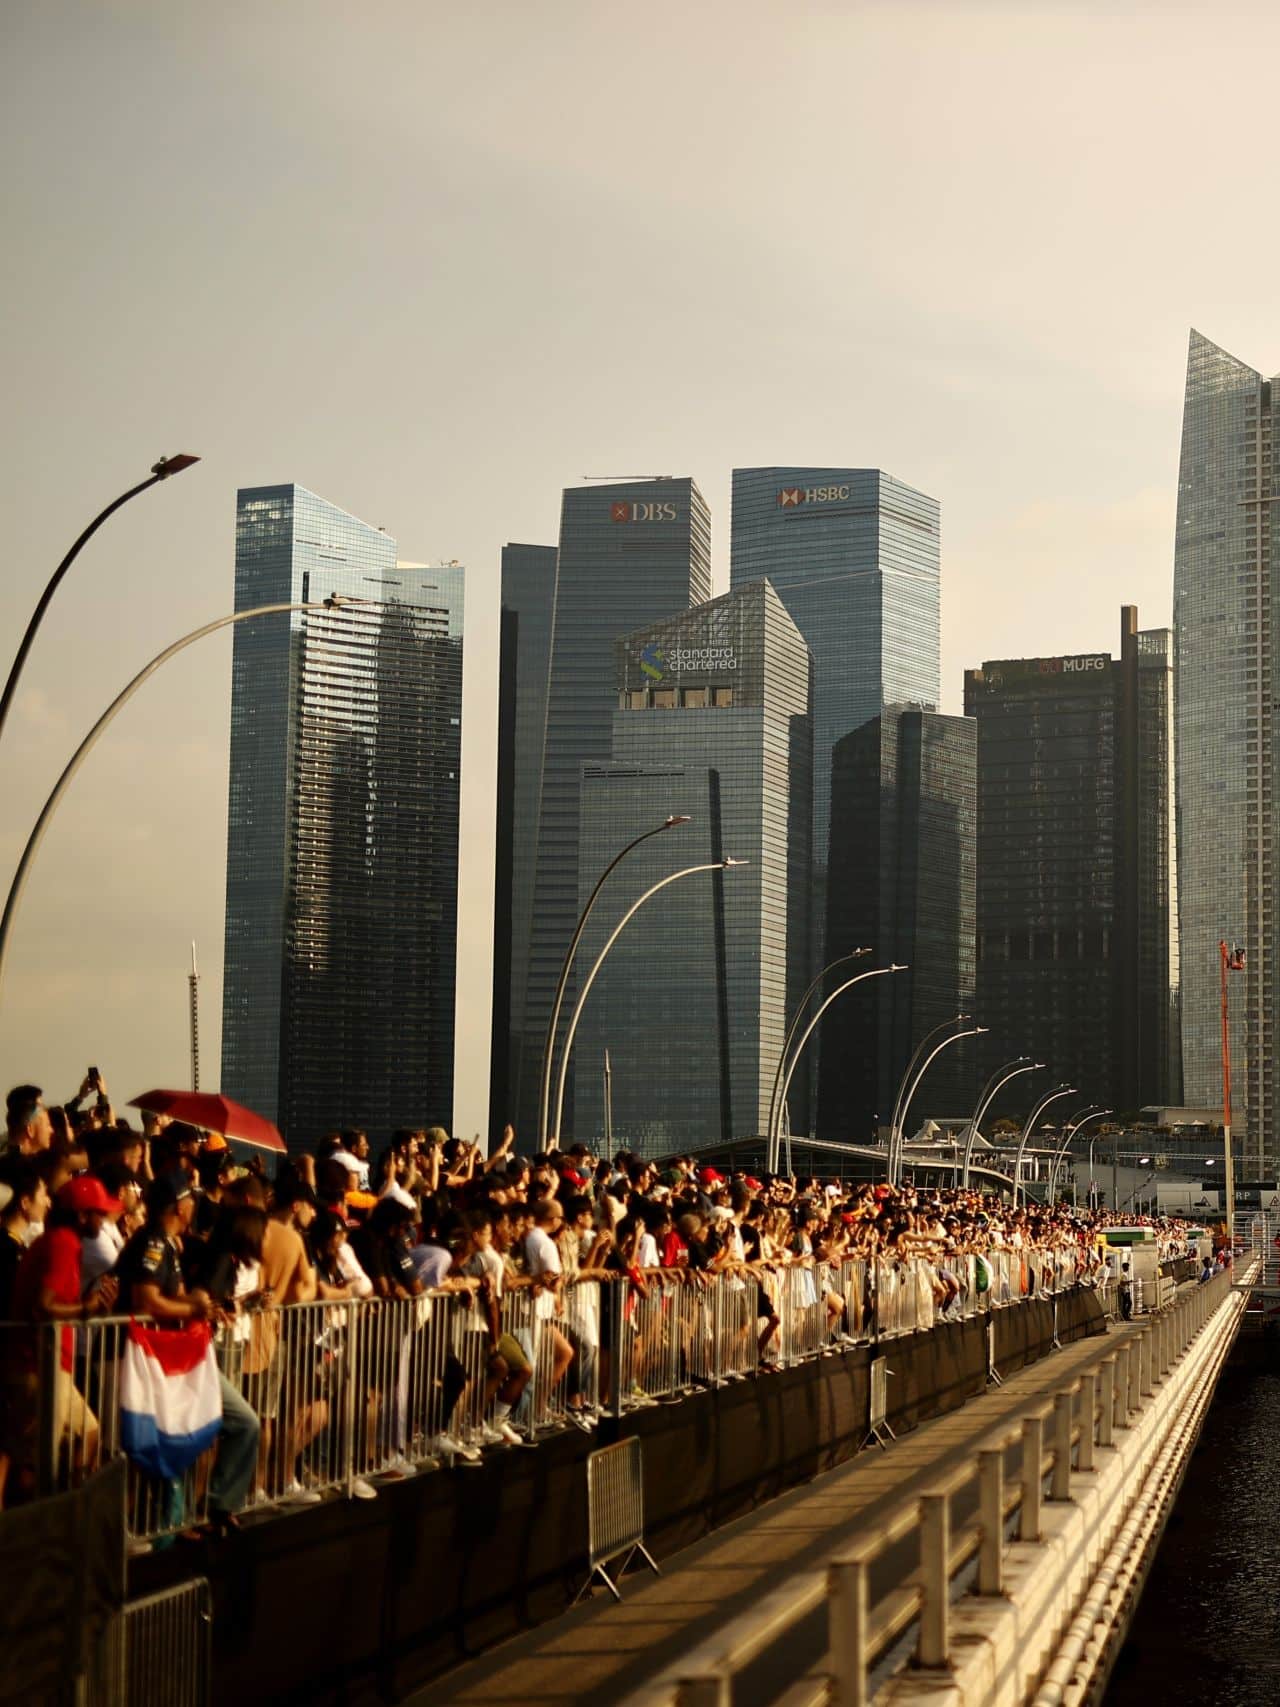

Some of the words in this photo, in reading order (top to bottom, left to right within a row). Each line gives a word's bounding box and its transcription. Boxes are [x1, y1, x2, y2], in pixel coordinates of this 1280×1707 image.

[804, 485, 849, 502] HSBC
[632, 503, 677, 521] DBS
[670, 646, 733, 660] standard
[670, 658, 737, 671] chartered
[1063, 658, 1105, 672] MUFG
